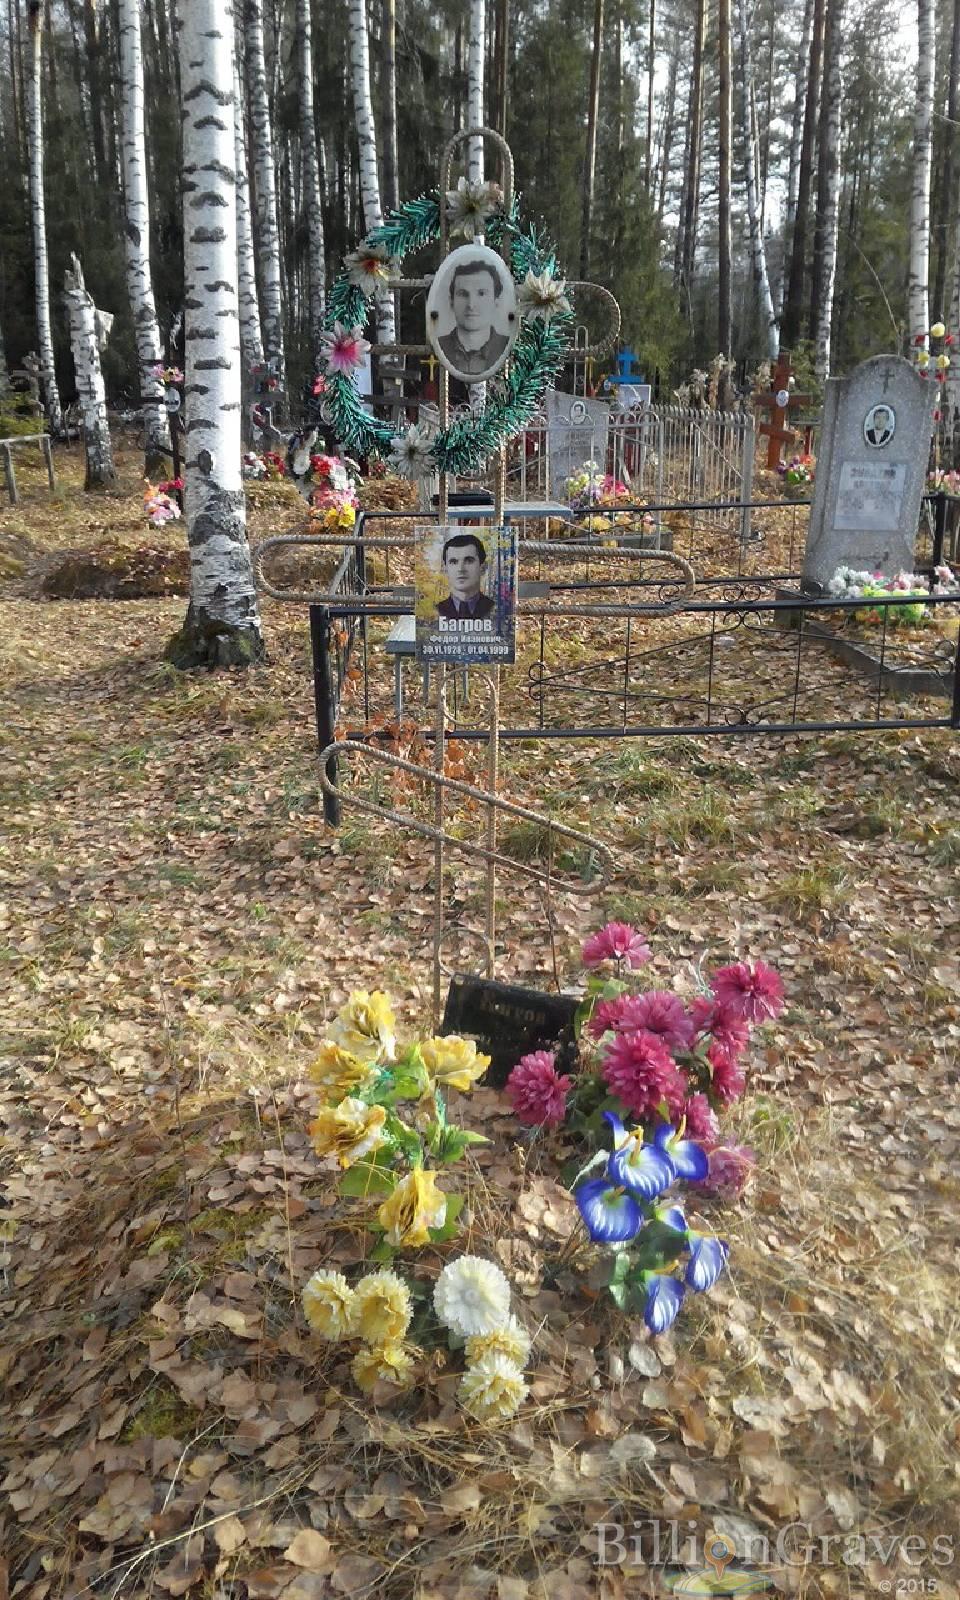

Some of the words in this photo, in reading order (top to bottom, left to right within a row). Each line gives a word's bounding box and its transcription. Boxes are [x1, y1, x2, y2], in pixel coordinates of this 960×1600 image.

[438, 616, 492, 632] Багров
[460, 635, 501, 643] Иванович
[467, 645, 509, 655] 01.04.1999
